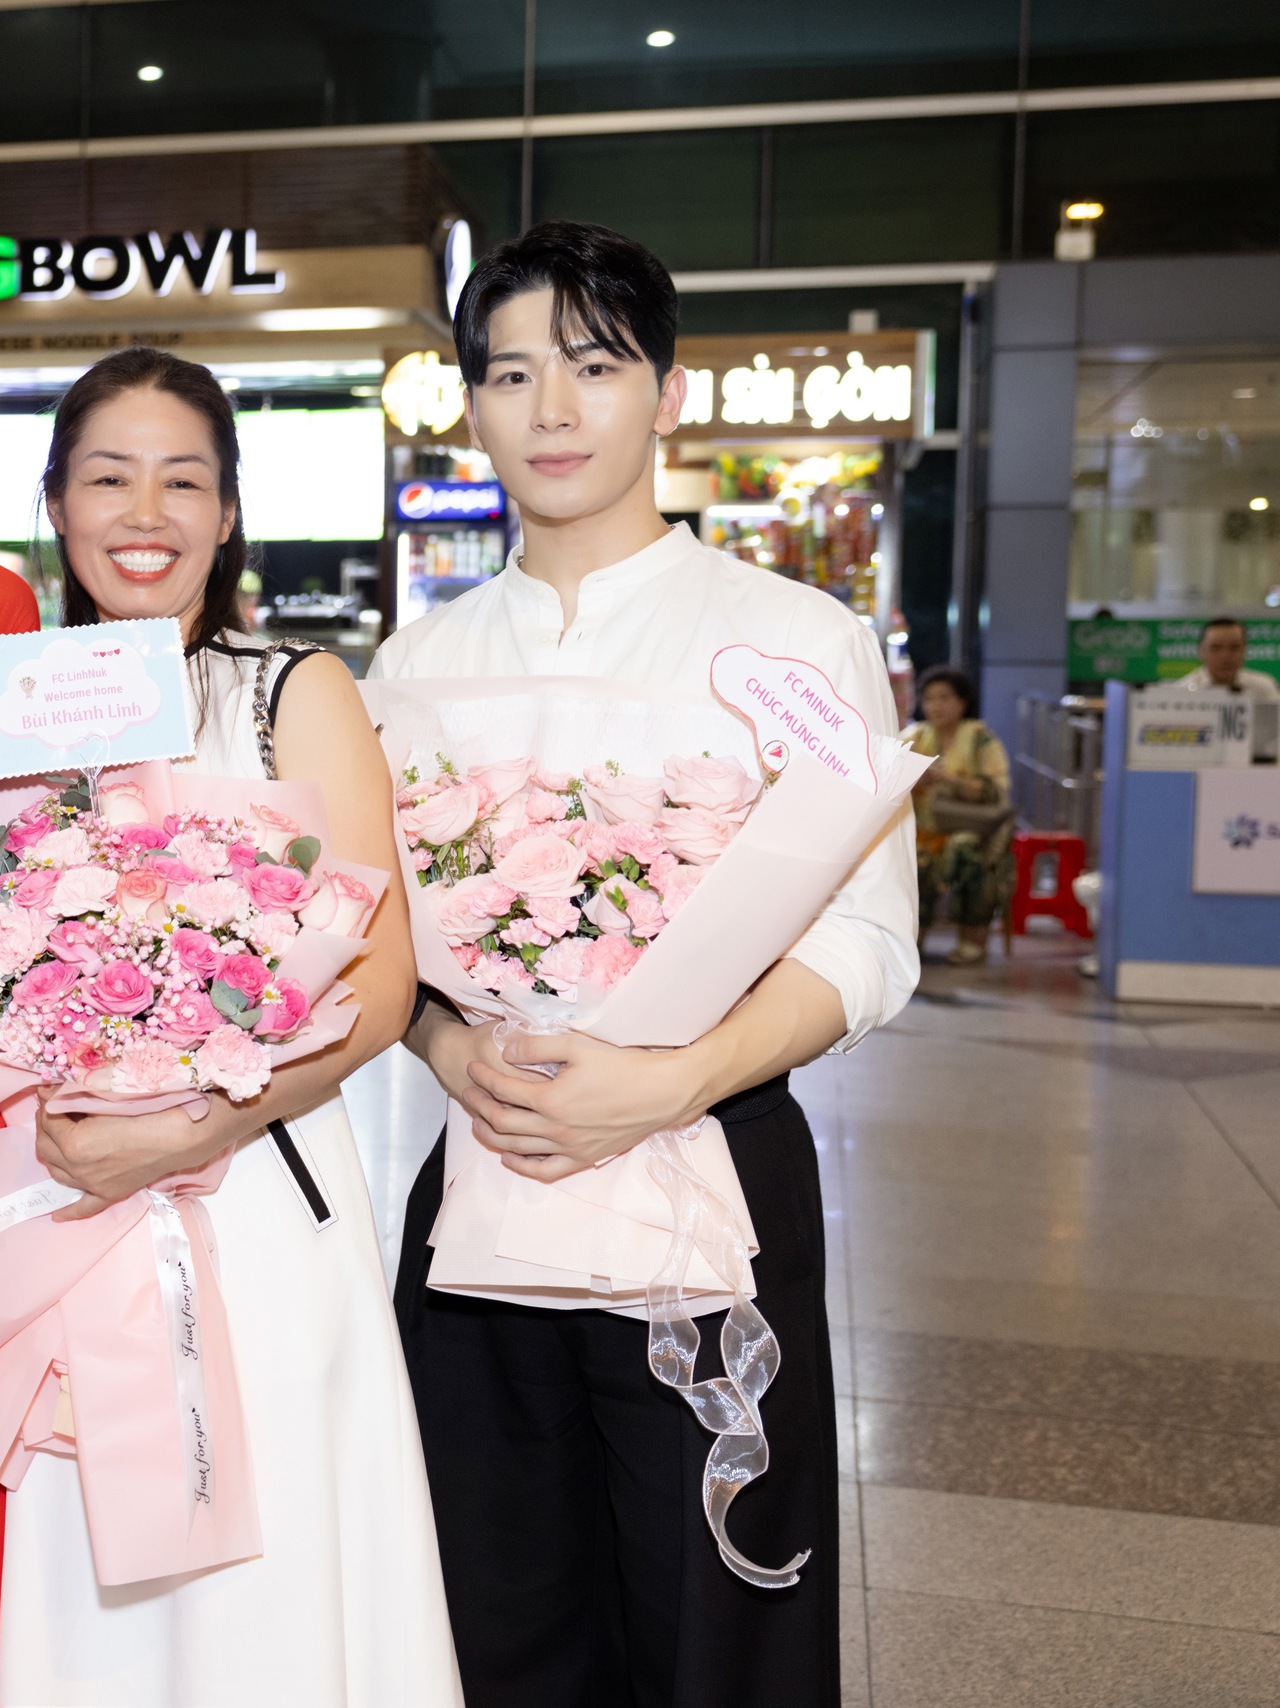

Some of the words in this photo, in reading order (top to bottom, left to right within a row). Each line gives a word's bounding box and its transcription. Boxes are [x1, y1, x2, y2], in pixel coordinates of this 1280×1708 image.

[51, 673, 65, 684] FC
[67, 668, 108, 682] LinhNuk
[44, 688, 92, 703] Welcome
[94, 684, 124, 697] home
[783, 671, 804, 693] FC
[799, 686, 846, 732] MINUK
[21, 711, 48, 730] Bùi
[51, 704, 104, 725] Khánh
[108, 702, 142, 719] Linh
[745, 677, 783, 715] CHÚC
[817, 745, 851, 778] LINH
[180, 1264, 193, 1296] you
[181, 1295, 196, 1326] for
[181, 1322, 199, 1361] Just
[193, 1412, 208, 1442] you
[193, 1441, 211, 1472] for
[194, 1468, 211, 1504] Just
